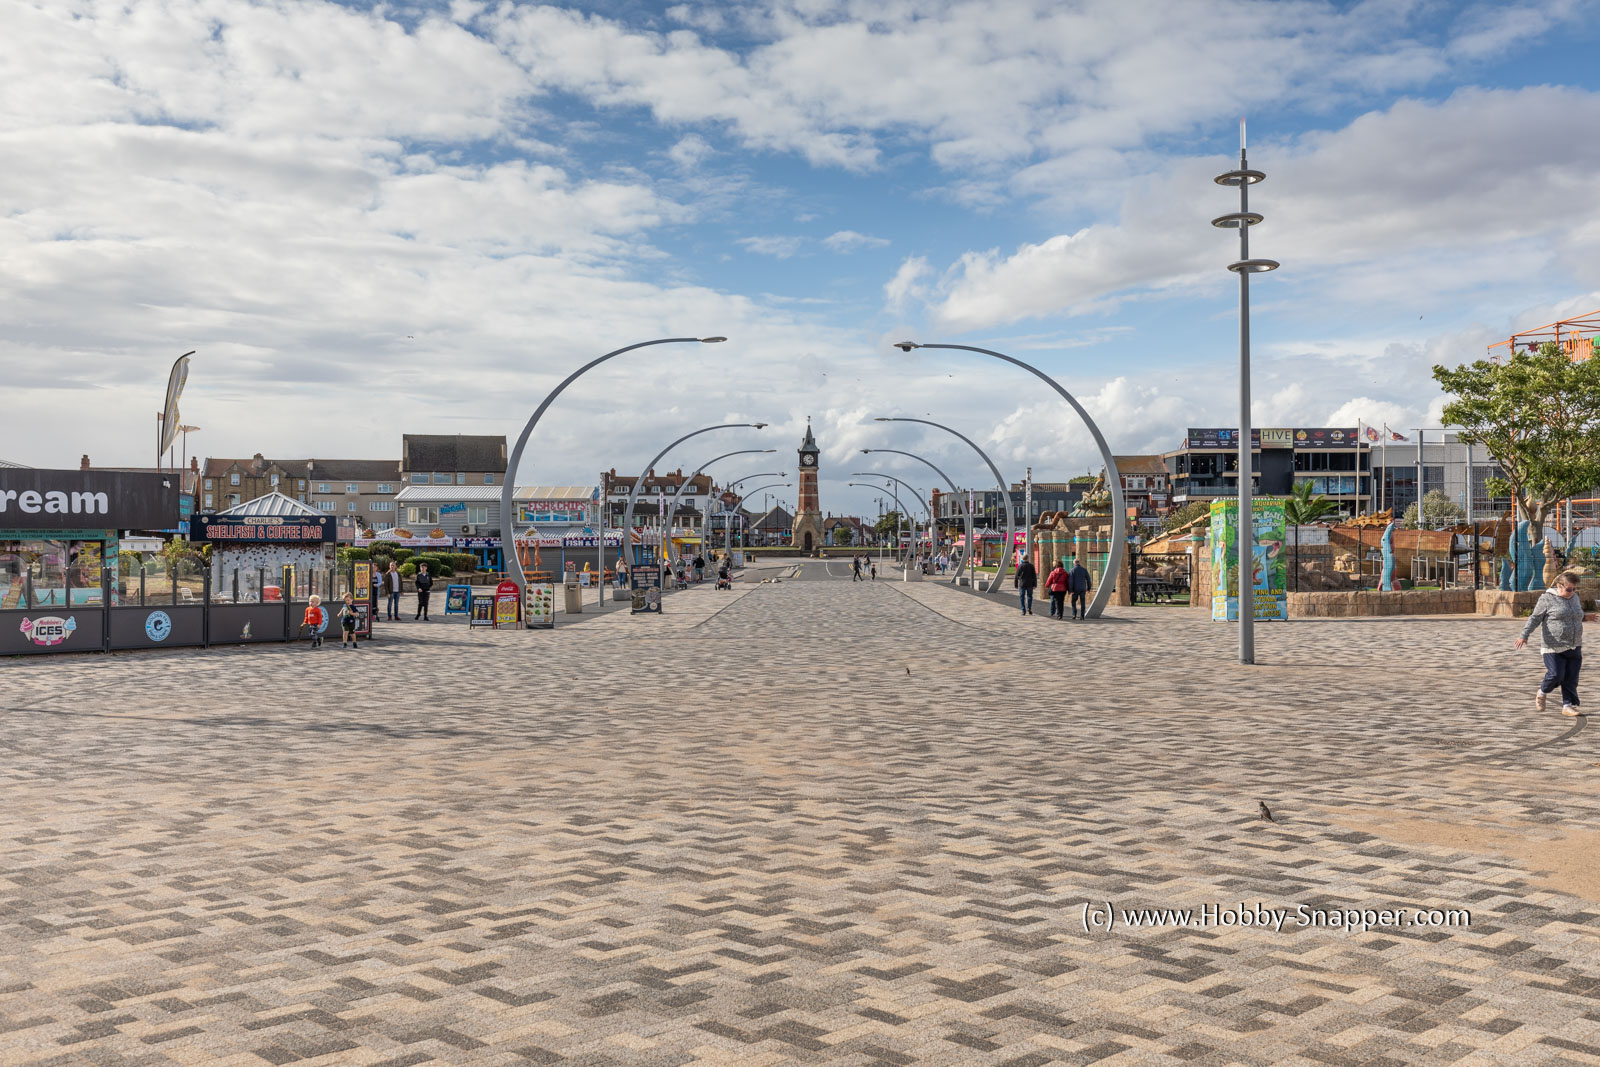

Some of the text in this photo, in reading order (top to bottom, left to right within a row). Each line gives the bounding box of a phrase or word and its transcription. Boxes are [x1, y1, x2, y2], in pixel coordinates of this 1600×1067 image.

[1262, 431, 1292, 440] HIVE
[206, 525, 256, 539] SHELLFISH
[257, 525, 265, 539] &
[267, 525, 299, 539] COFFEE
[301, 525, 323, 539] BAR
[35, 626, 62, 636] ICES
